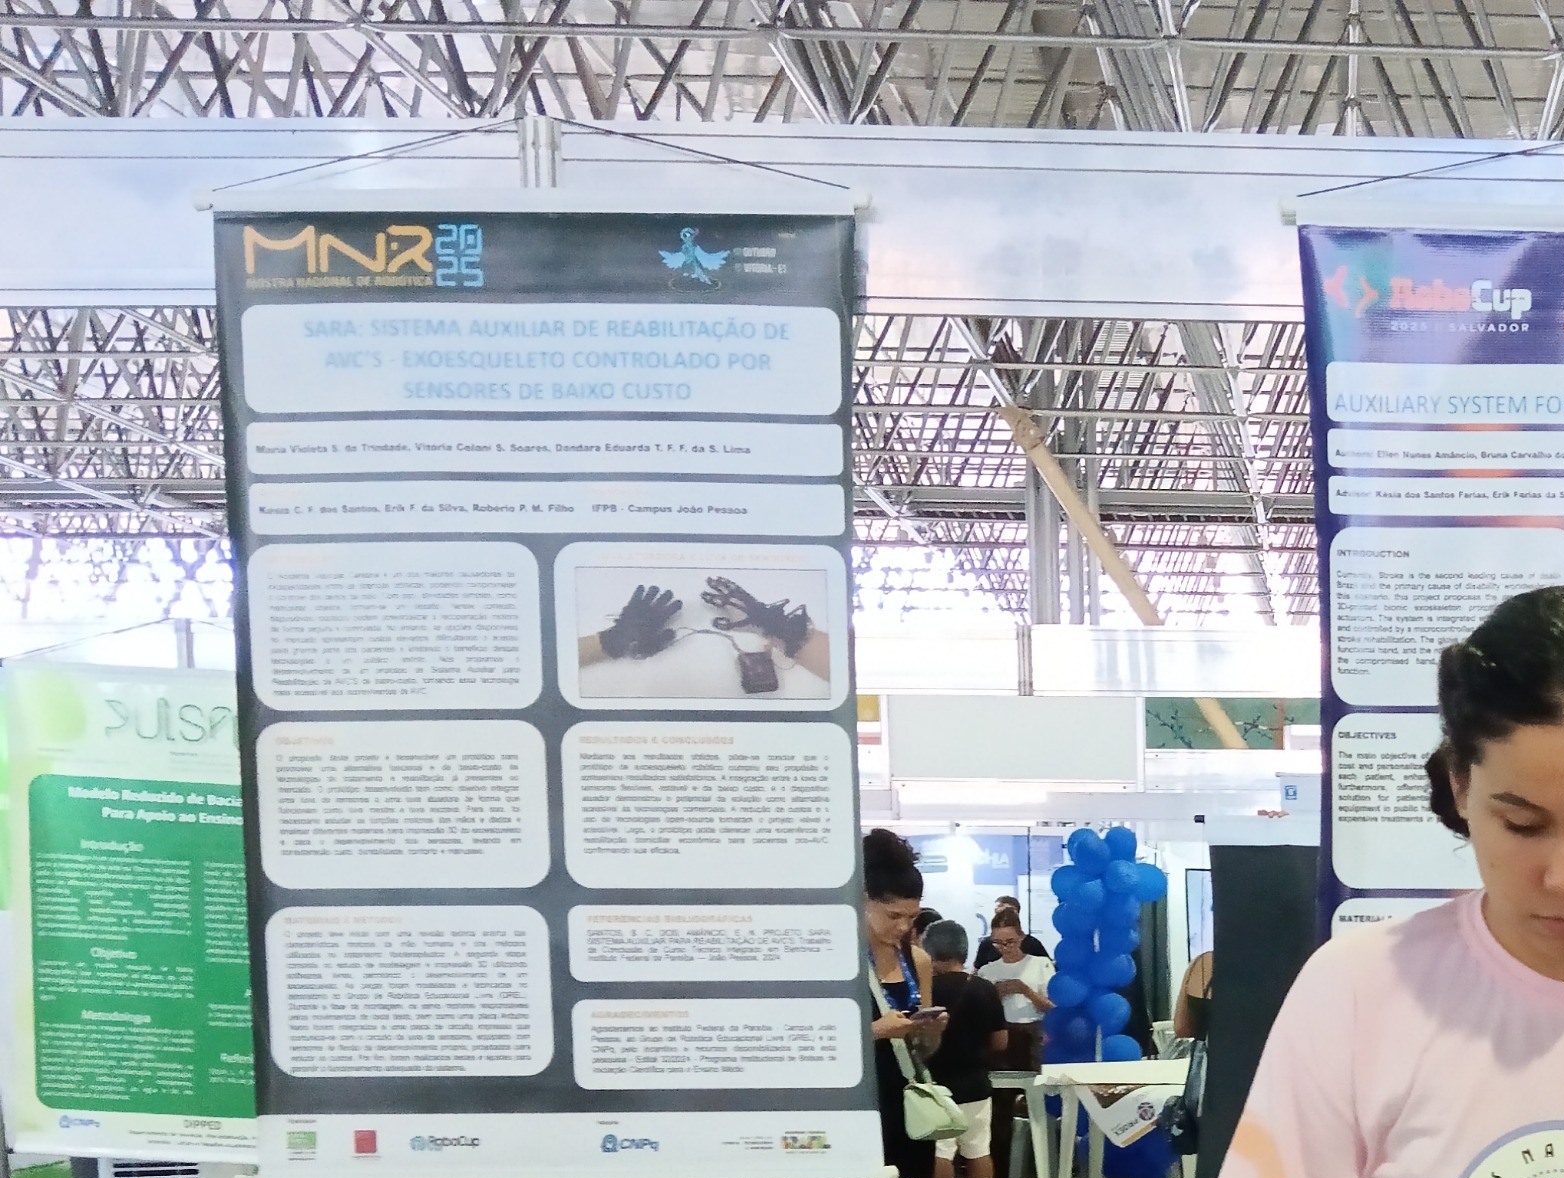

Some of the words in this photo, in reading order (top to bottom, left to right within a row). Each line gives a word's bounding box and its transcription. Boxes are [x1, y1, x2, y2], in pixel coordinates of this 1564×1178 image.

[304, 321, 363, 337] SARA:
[371, 320, 460, 336] SISTEMA
[470, 320, 565, 337] AUXILIAR
[573, 321, 598, 336] DE
[606, 318, 756, 343] REABILITAÇÃO
[764, 323, 789, 339] DE
[1449, 323, 1529, 332] SALVADOR
[402, 351, 565, 370] EXOESQUELETO
[573, 352, 720, 369] CONTROLADO
[728, 353, 771, 370] POR
[403, 382, 510, 400] SENSORES
[519, 383, 544, 400] DE
[552, 382, 614, 400] BAIXO
[622, 383, 691, 400] CUSTO
[1335, 394, 1440, 413] AUXILIARY
[1448, 396, 1526, 414] SYSTEM
[1337, 550, 1410, 558] INTRODUCTION
[102, 807, 134, 819] Para
[1521, 1143, 1555, 1164] NA
